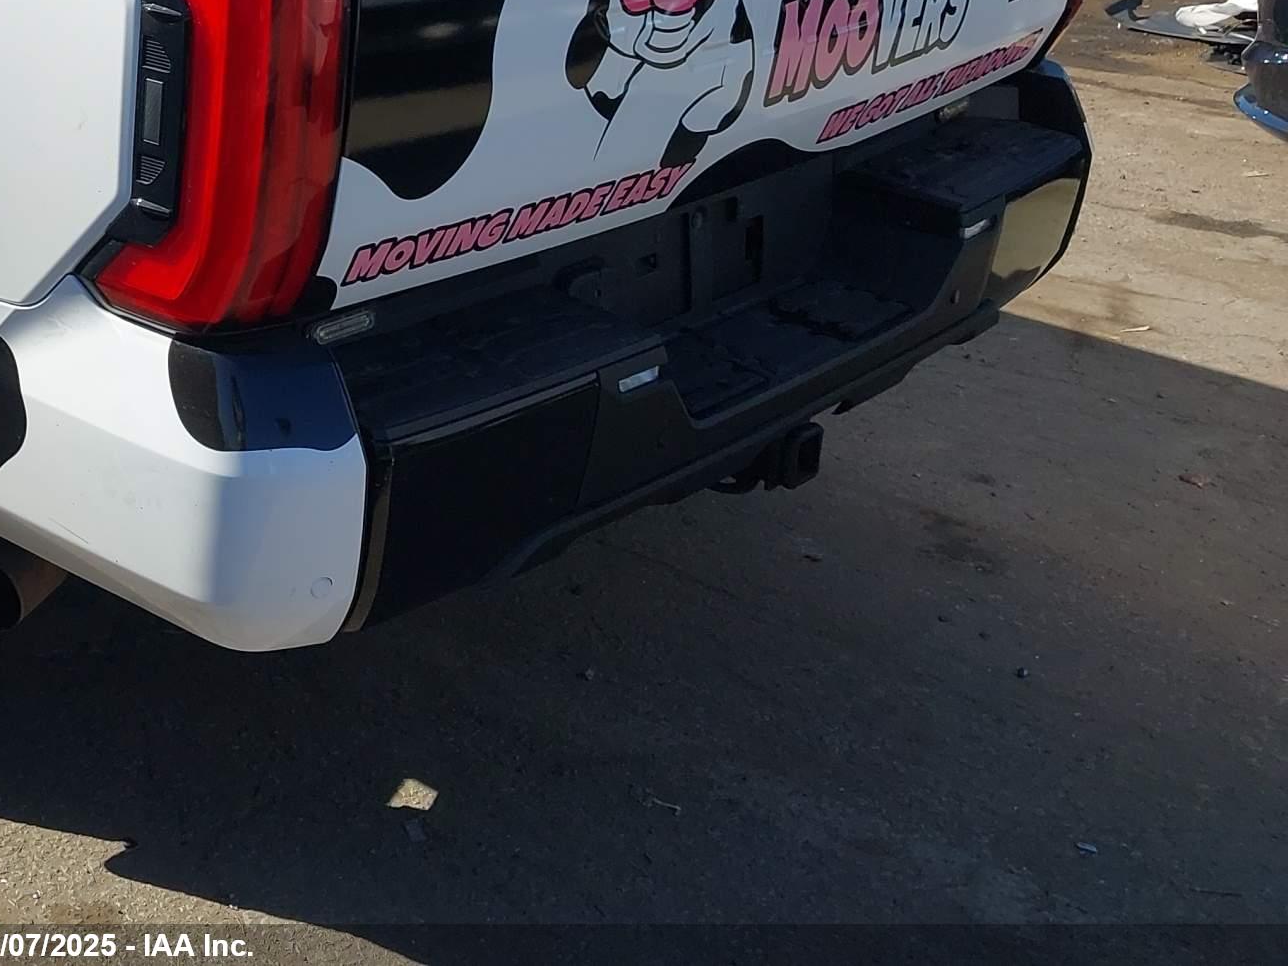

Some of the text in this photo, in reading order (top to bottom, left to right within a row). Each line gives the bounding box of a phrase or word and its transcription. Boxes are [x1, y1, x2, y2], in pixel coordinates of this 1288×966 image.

[816, 100, 869, 144] WE
[855, 82, 913, 130] GOT
[896, 72, 945, 113] ALL
[340, 162, 694, 287] MOVING MADE EASY
